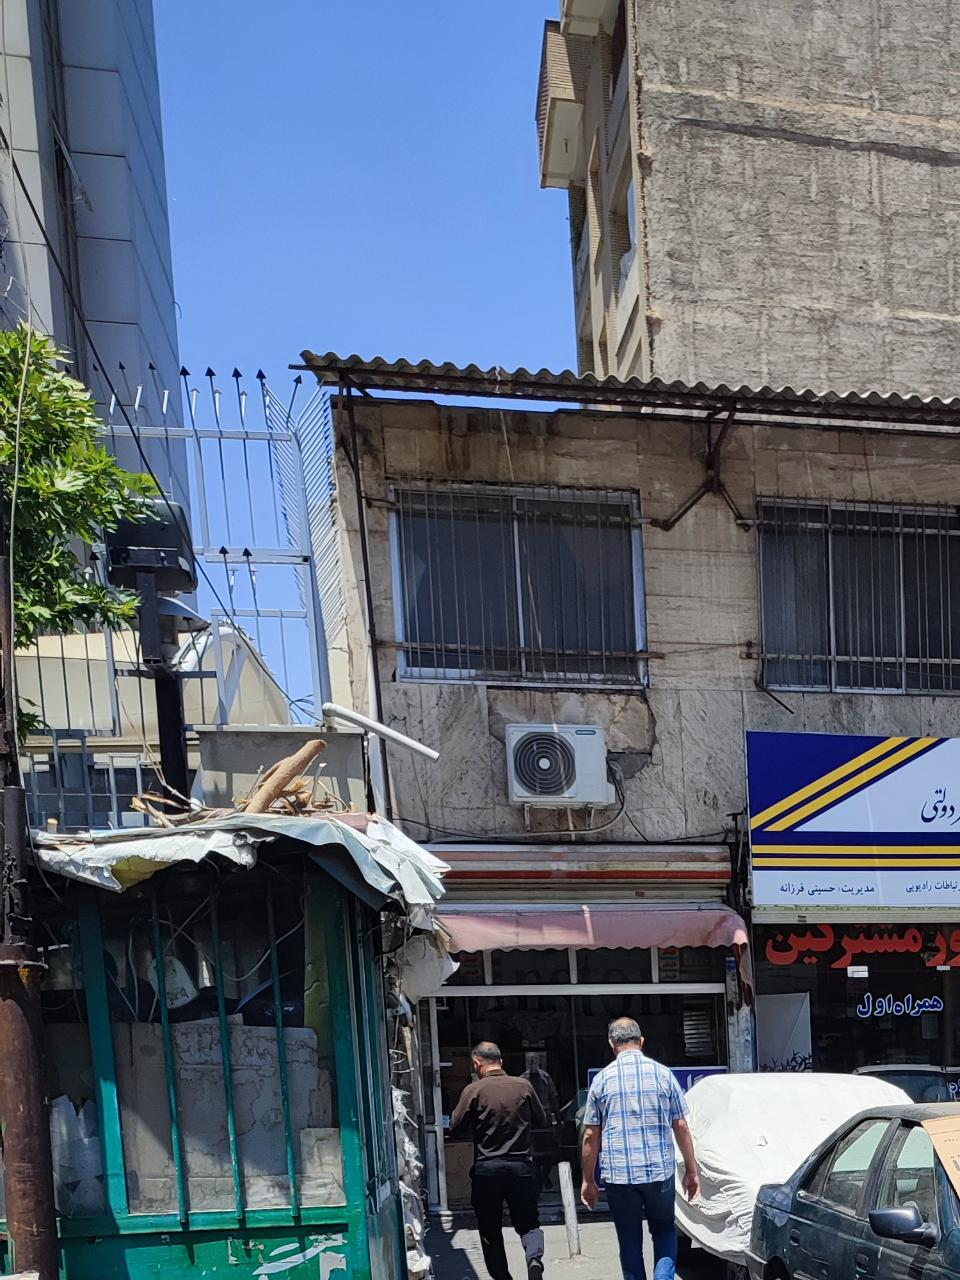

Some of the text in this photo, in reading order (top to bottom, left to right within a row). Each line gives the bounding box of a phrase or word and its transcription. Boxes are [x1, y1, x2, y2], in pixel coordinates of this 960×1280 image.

[920, 787, 955, 824] دولتی
[779, 882, 805, 896] فرزانه
[807, 883, 835, 896] حسینی
[905, 880, 932, 893] رادیویی
[856, 992, 944, 1018] همراه اول
